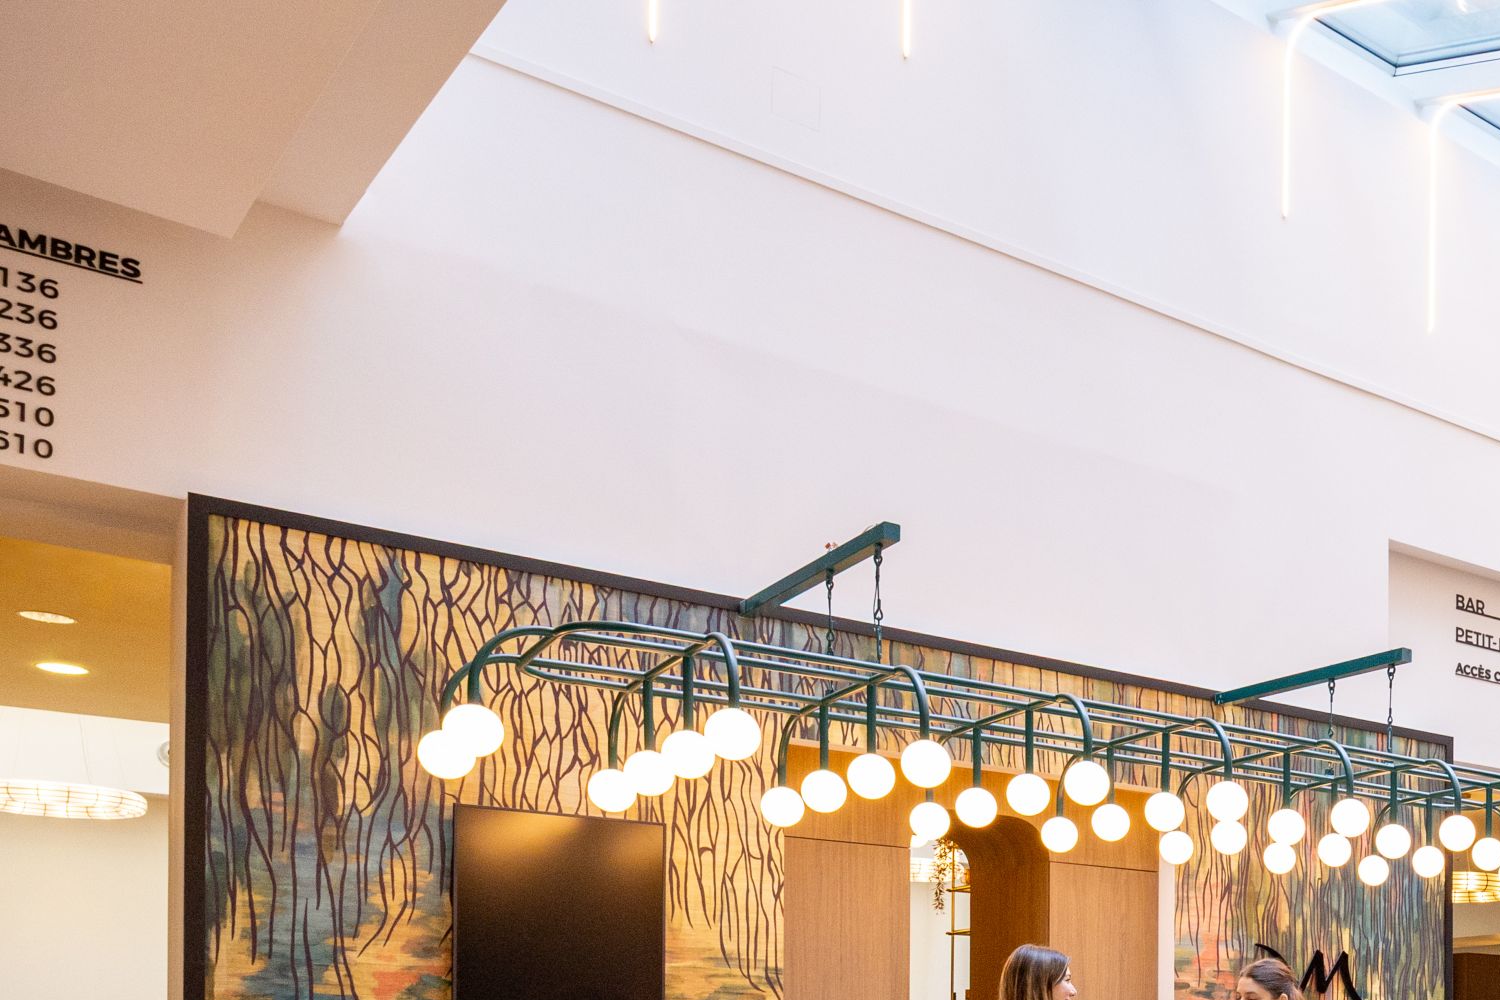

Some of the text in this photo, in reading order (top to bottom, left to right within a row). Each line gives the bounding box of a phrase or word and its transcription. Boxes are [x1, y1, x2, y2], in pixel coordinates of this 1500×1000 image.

[0, 224, 141, 278] AMBRES
[0, 266, 59, 299] 136
[0, 298, 58, 330] 236
[1456, 594, 1485, 615] BAR
[1455, 662, 1491, 680] ACCÈS
